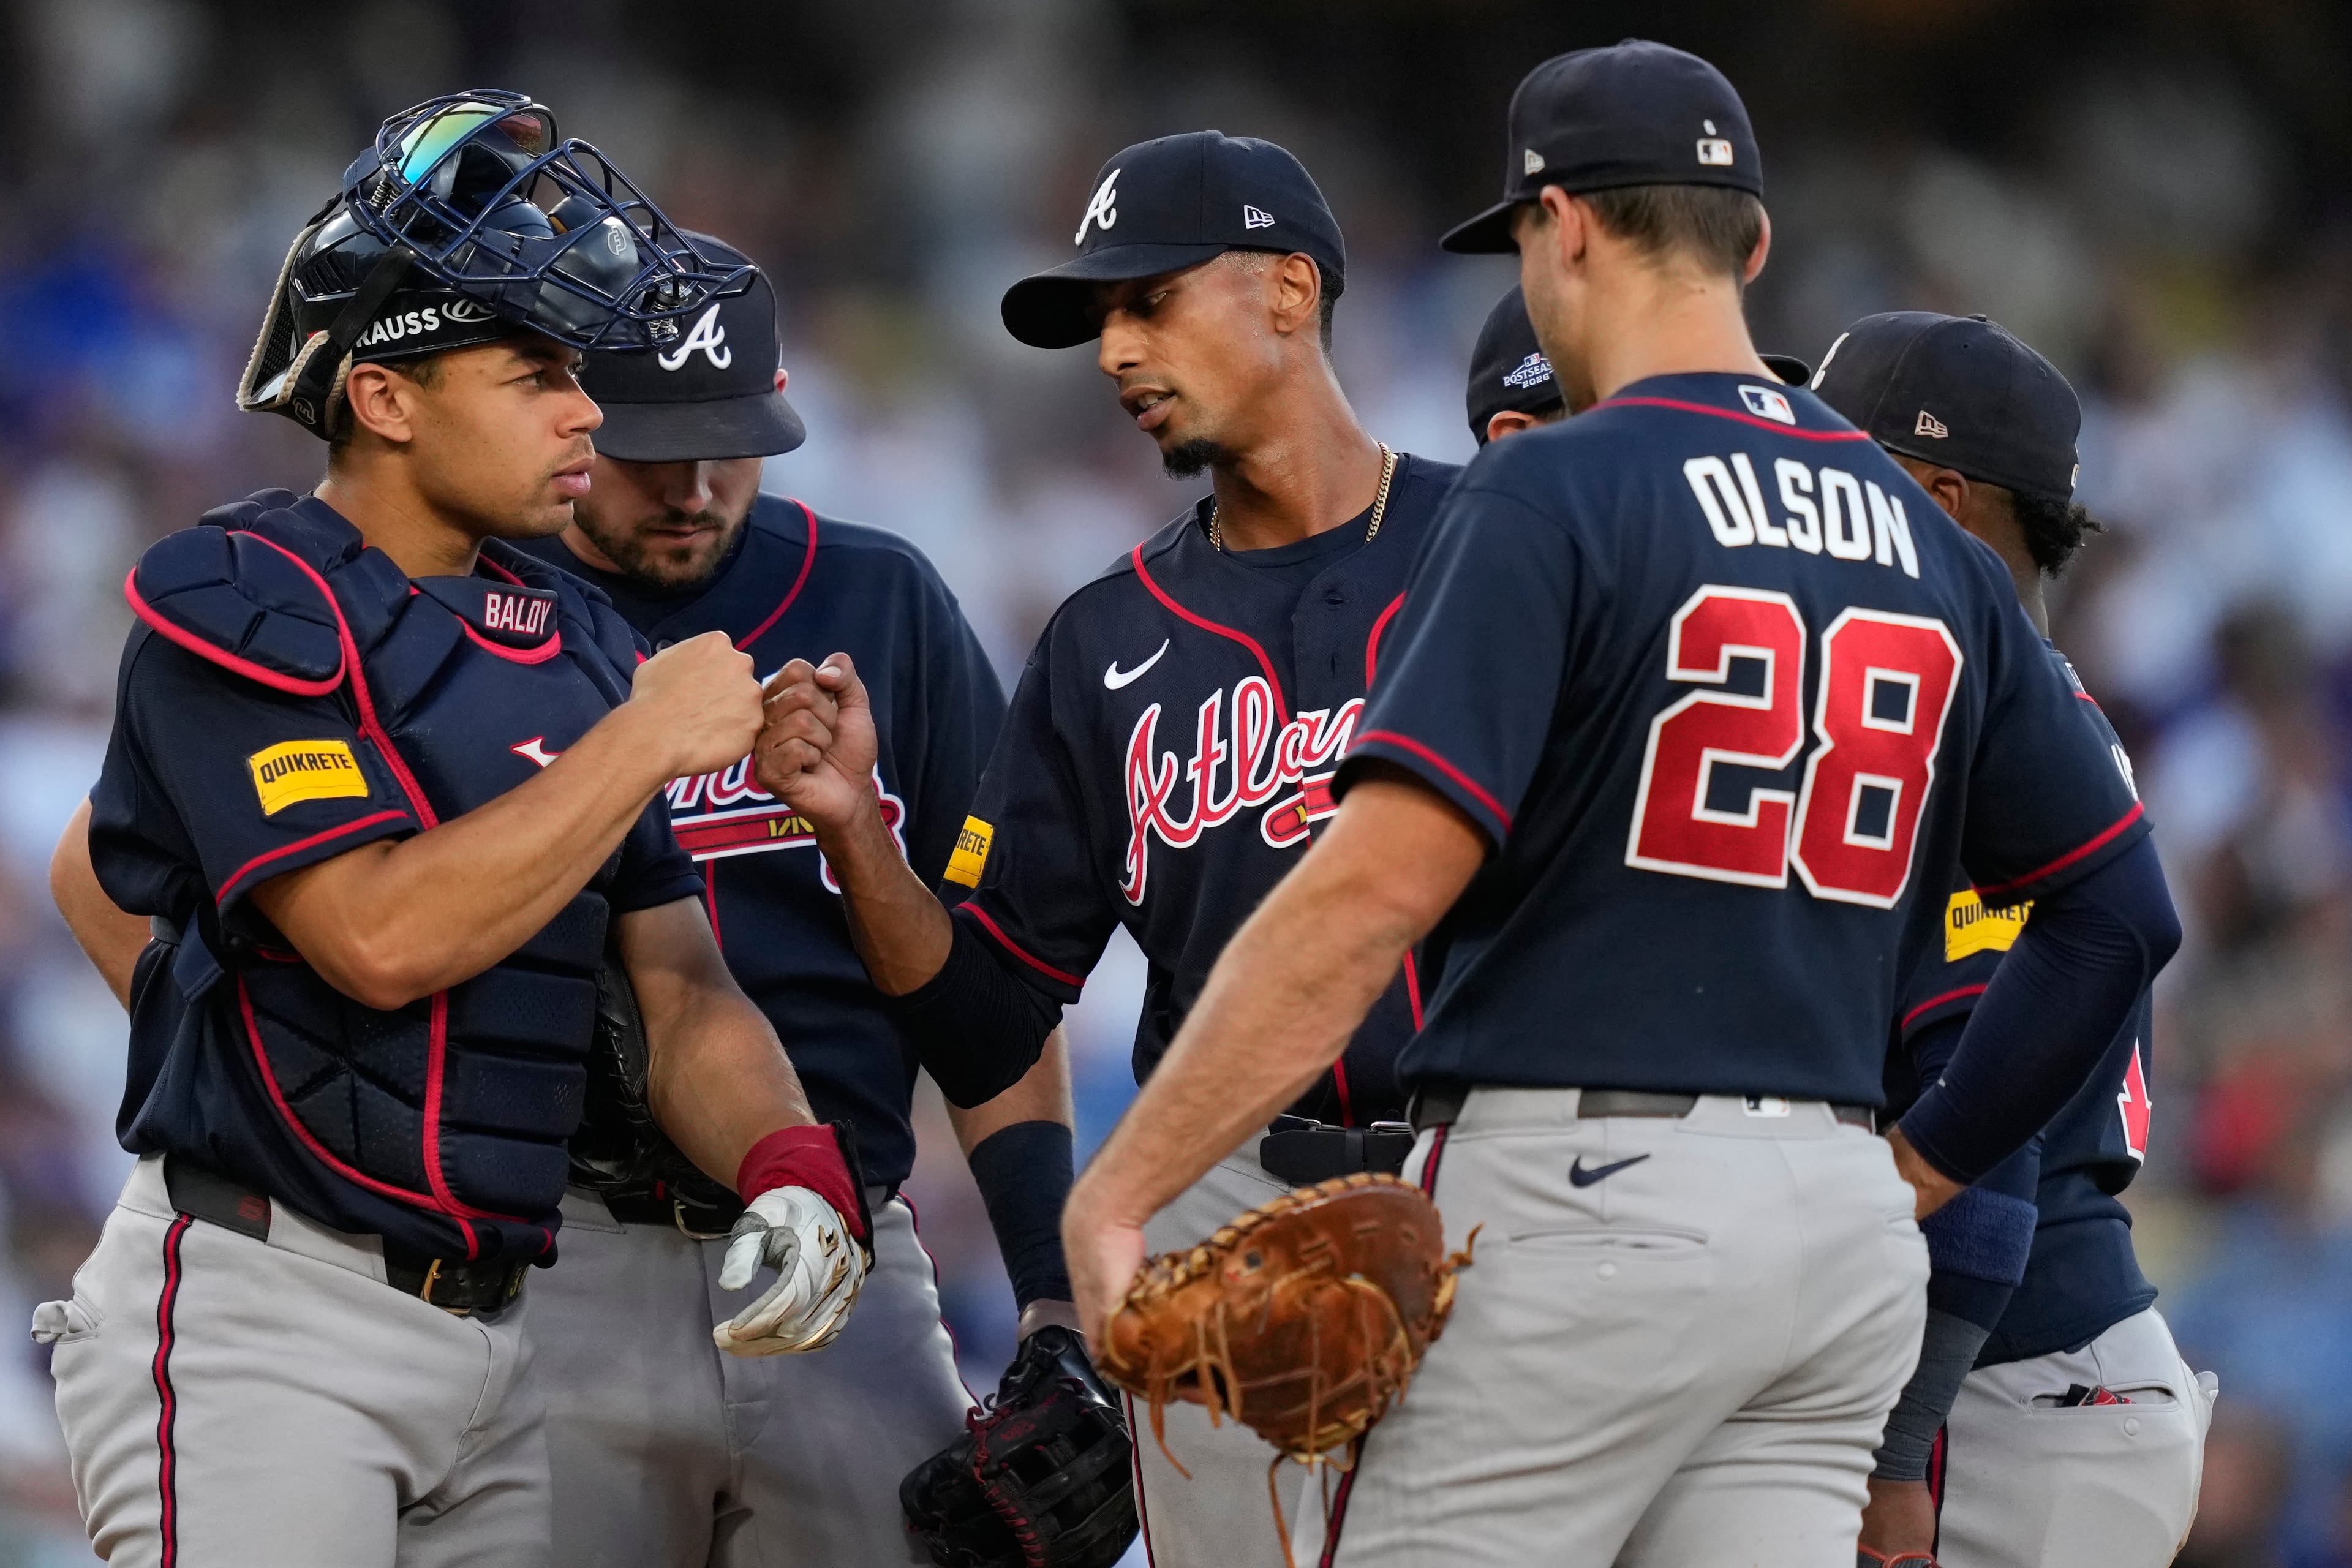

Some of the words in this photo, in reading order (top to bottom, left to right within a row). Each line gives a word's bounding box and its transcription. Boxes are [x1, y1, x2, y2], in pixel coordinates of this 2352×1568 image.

[1075, 168, 1121, 246] A
[658, 303, 731, 371] A
[1683, 452, 1920, 579] OLSON
[260, 753, 353, 785] QUIKRETE
[1625, 584, 1964, 910] 28
